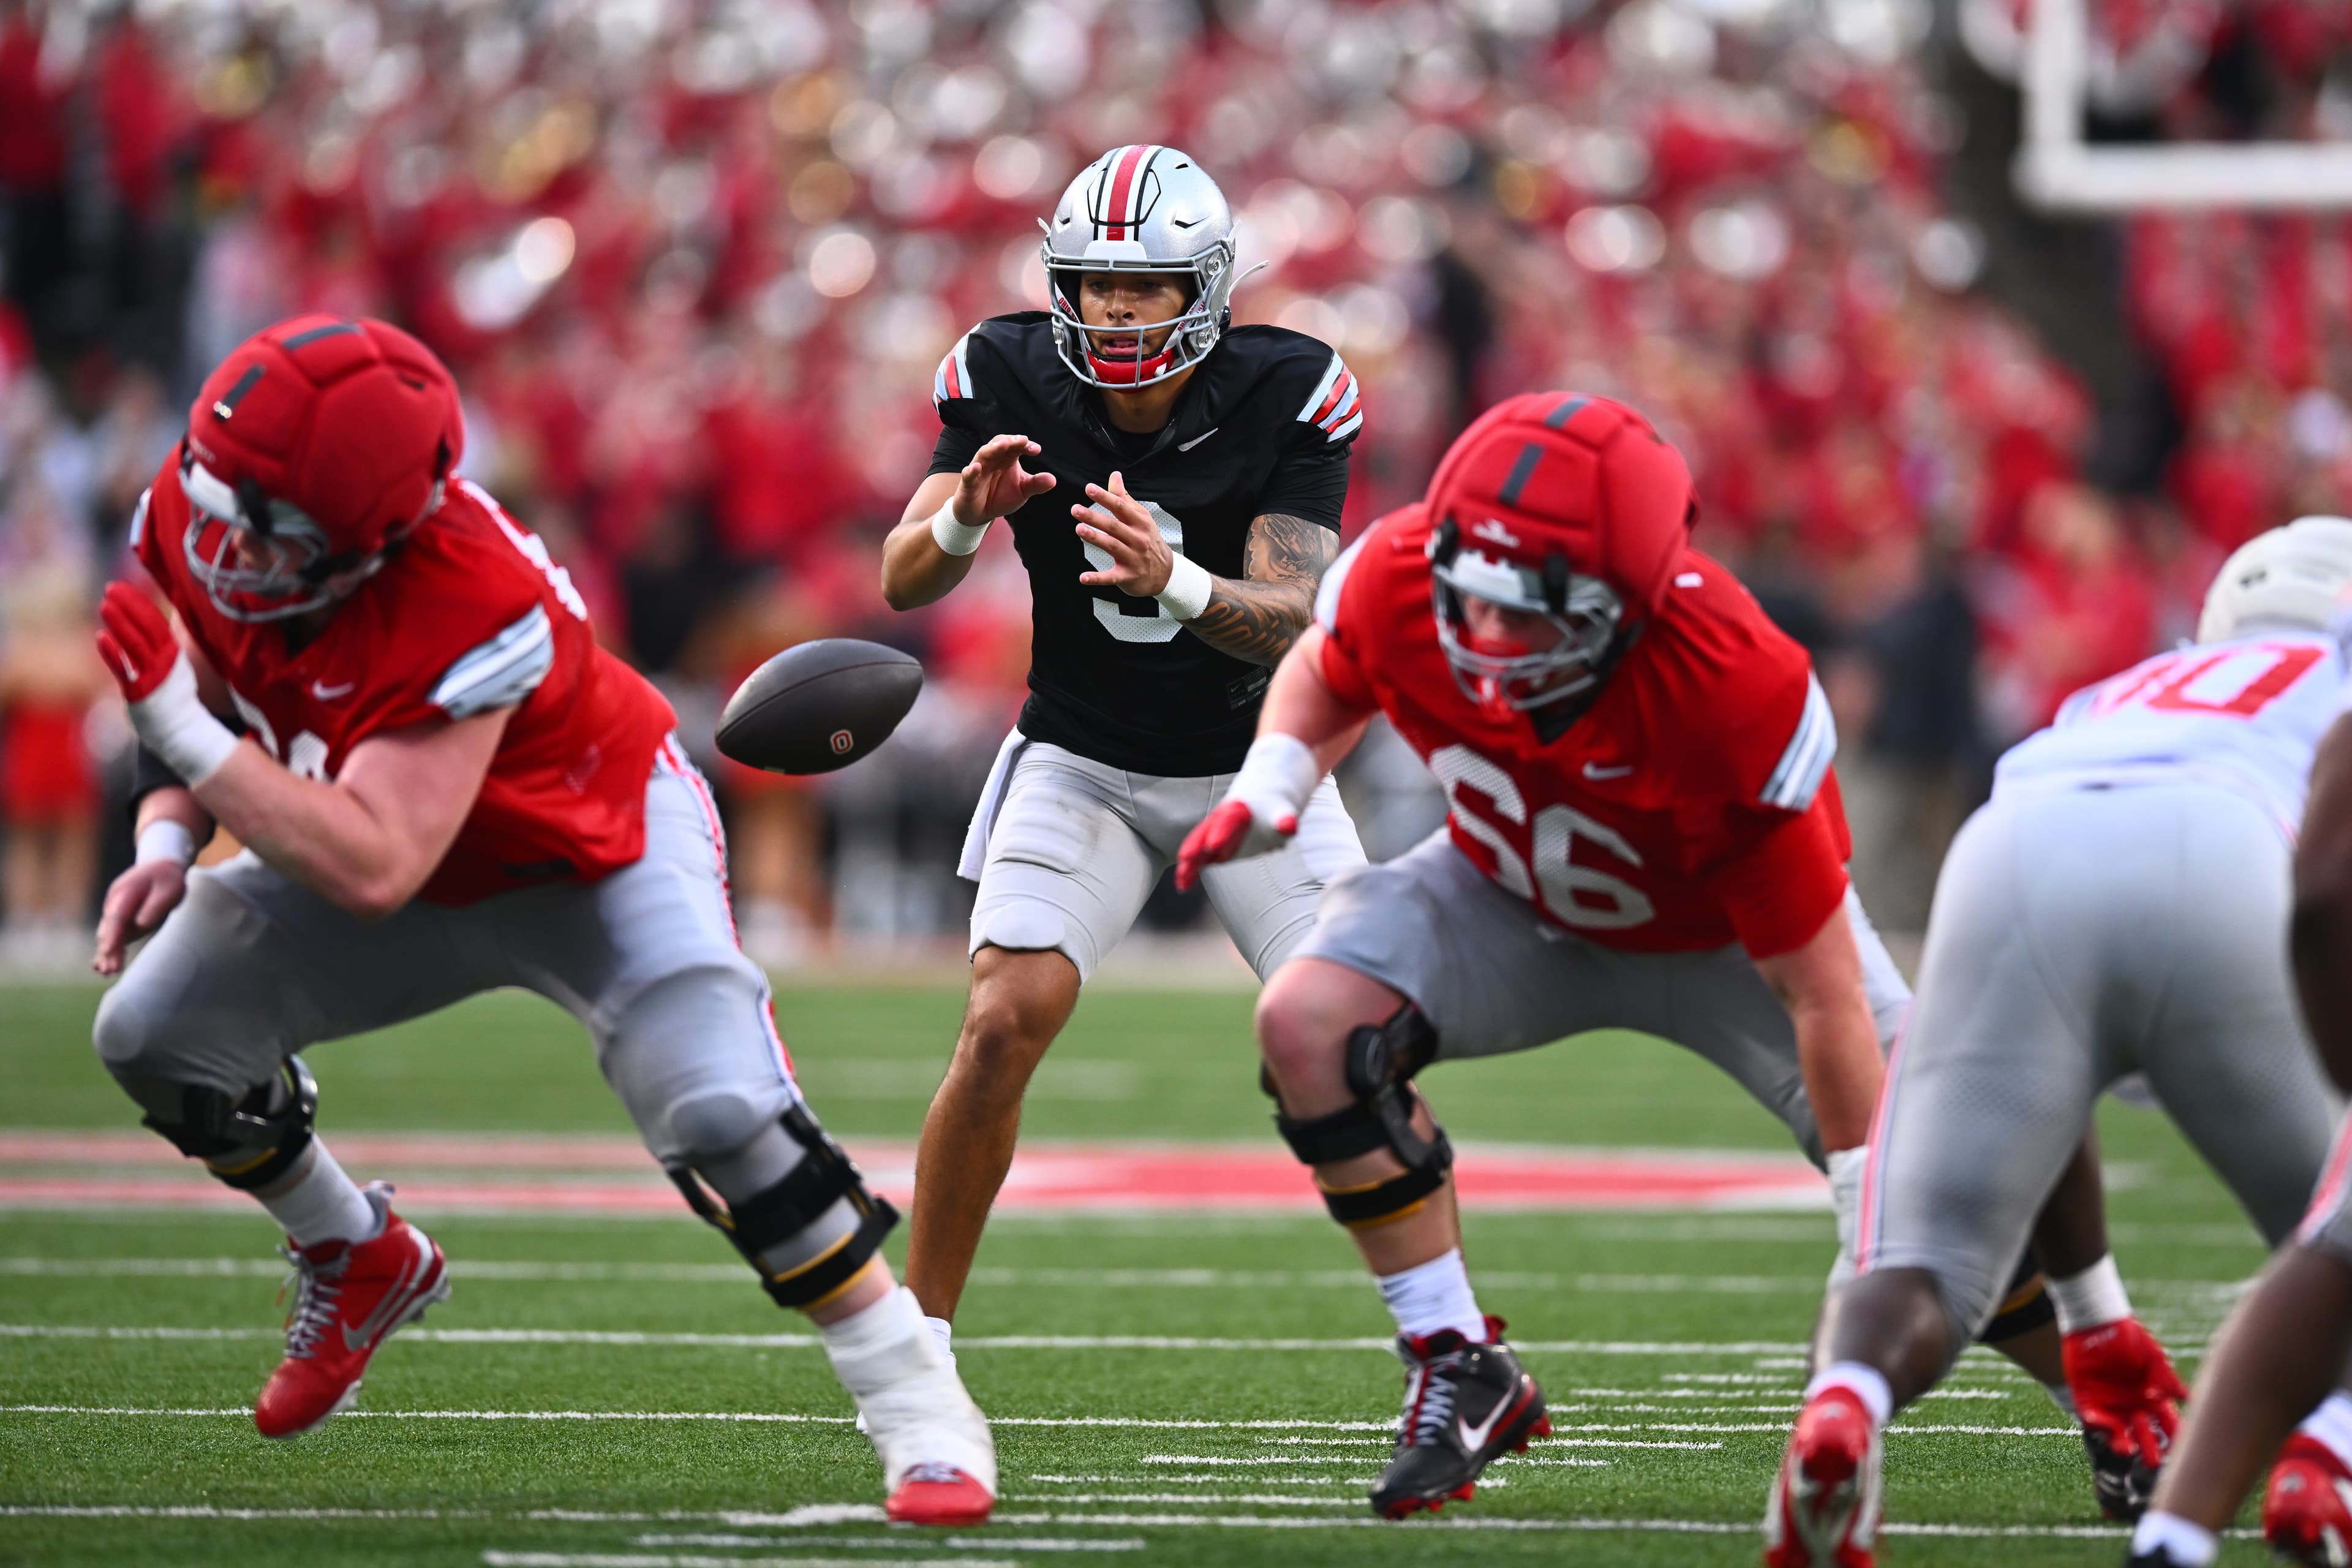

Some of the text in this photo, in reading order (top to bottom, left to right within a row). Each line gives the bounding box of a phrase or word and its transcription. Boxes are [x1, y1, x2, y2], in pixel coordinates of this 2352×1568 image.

[1058, 297, 1071, 313] OHIO
[1082, 500, 1184, 643] 9
[1428, 744, 1656, 930] 66
